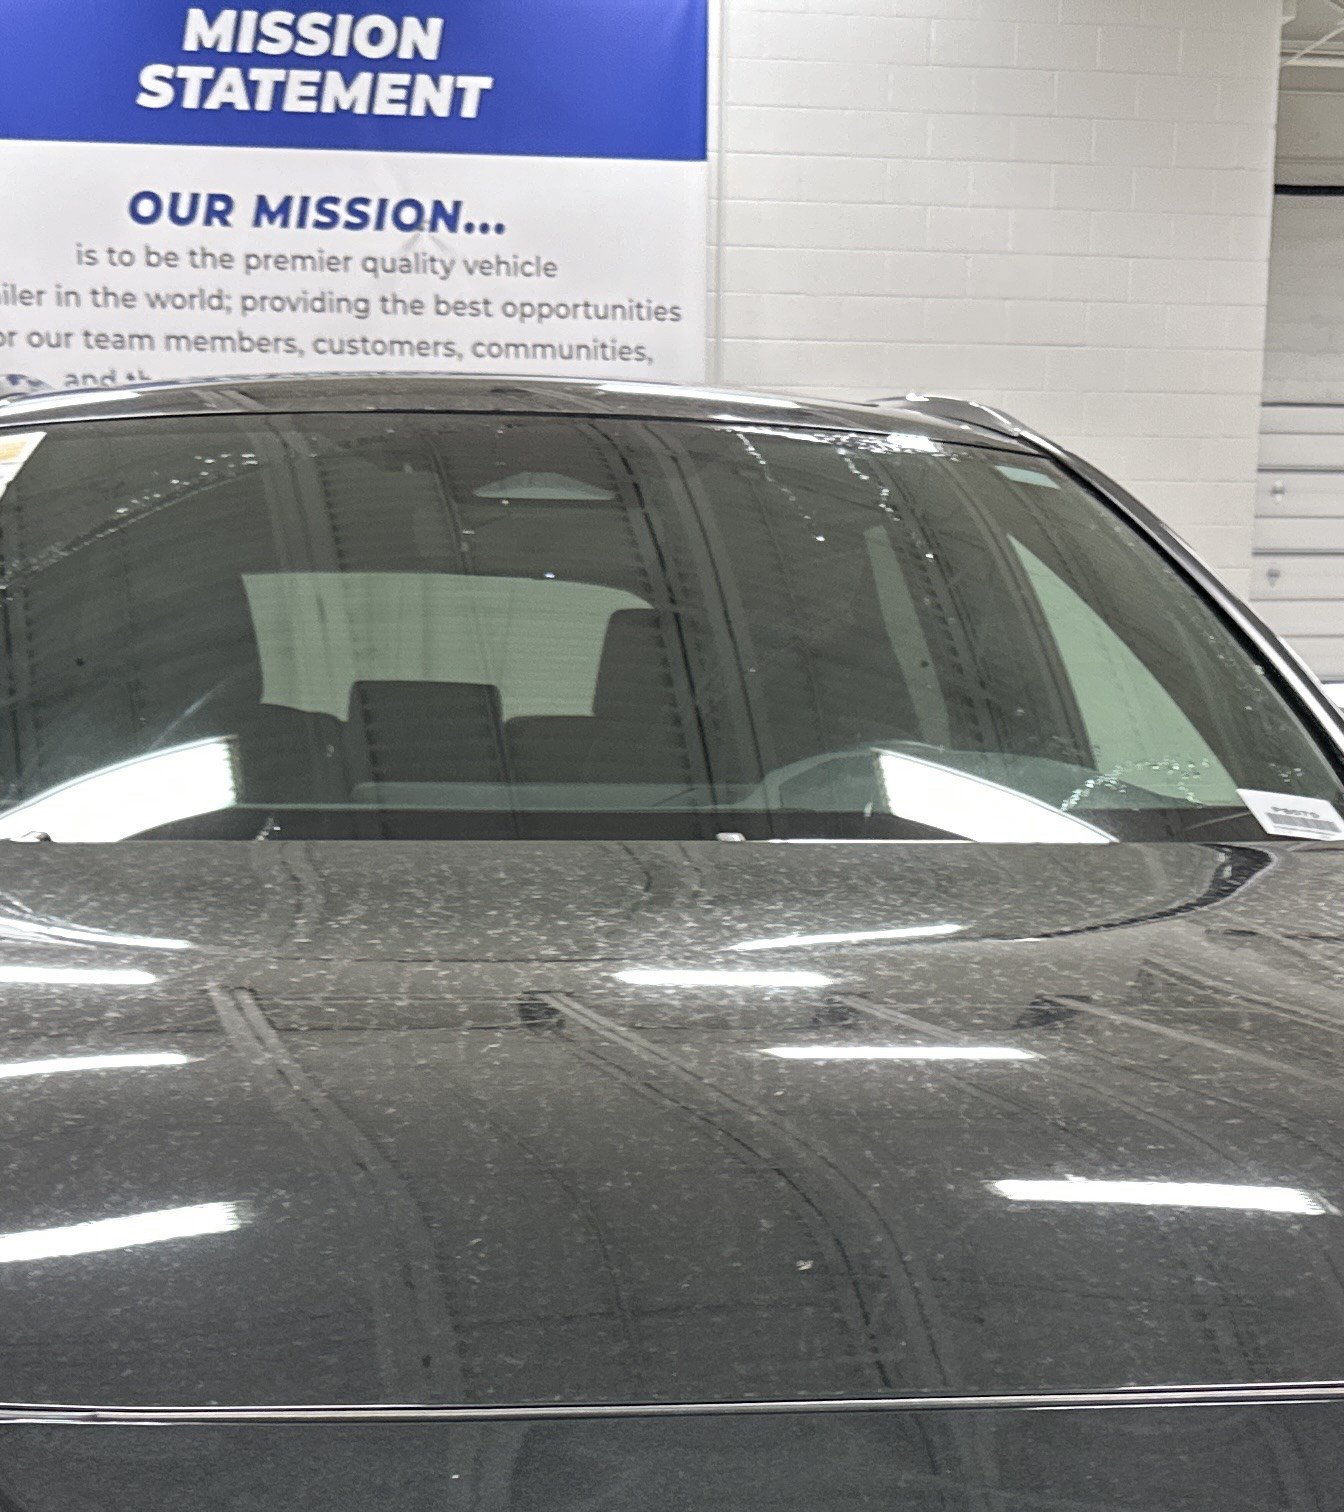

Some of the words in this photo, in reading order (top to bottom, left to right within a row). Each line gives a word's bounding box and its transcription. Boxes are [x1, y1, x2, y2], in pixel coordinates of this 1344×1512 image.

[182, 7, 443, 61] MISSION
[135, 64, 494, 119] STATEMENT
[127, 190, 235, 228] OUR
[252, 194, 506, 235] MISSION...
[75, 242, 98, 267] is
[107, 246, 134, 268] to
[144, 244, 180, 269] be
[189, 246, 234, 271] the
[245, 249, 353, 278] premier
[362, 251, 454, 282] quality
[462, 253, 558, 279] vehicle
[55, 283, 80, 308] in
[90, 285, 137, 310] the
[146, 287, 232, 315] world;
[240, 289, 370, 320] providing
[380, 293, 425, 318] the
[434, 294, 492, 319] best
[501, 297, 682, 324] opportunities
[27, 329, 73, 350] our
[83, 329, 155, 352] team
[164, 329, 304, 358] members,
[313, 335, 462, 361] customers,
[471, 337, 653, 364] communities,
[65, 368, 116, 387] and
